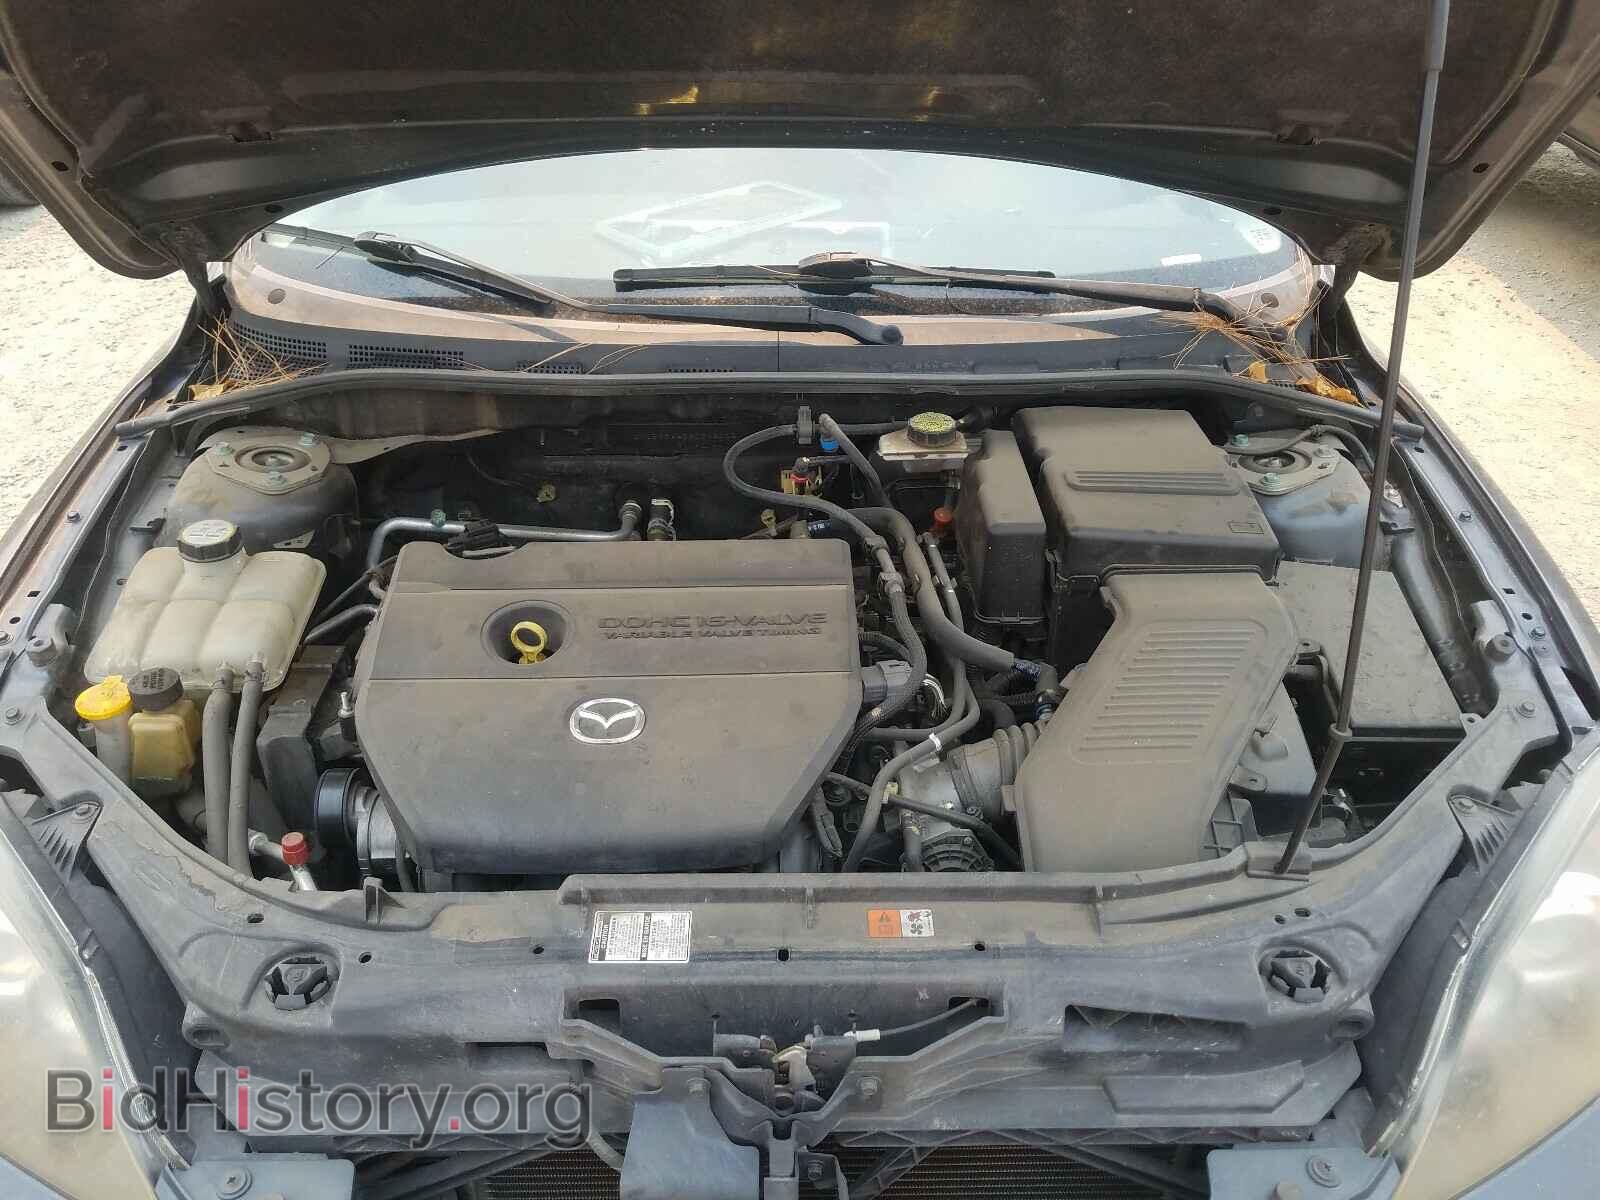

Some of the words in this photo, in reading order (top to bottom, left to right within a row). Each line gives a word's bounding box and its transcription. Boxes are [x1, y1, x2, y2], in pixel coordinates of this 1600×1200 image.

[598, 616, 691, 629] DOHC
[694, 613, 827, 628] 16-VALVE
[603, 630, 693, 640] VARIABLE
[696, 629, 753, 639] VALVE
